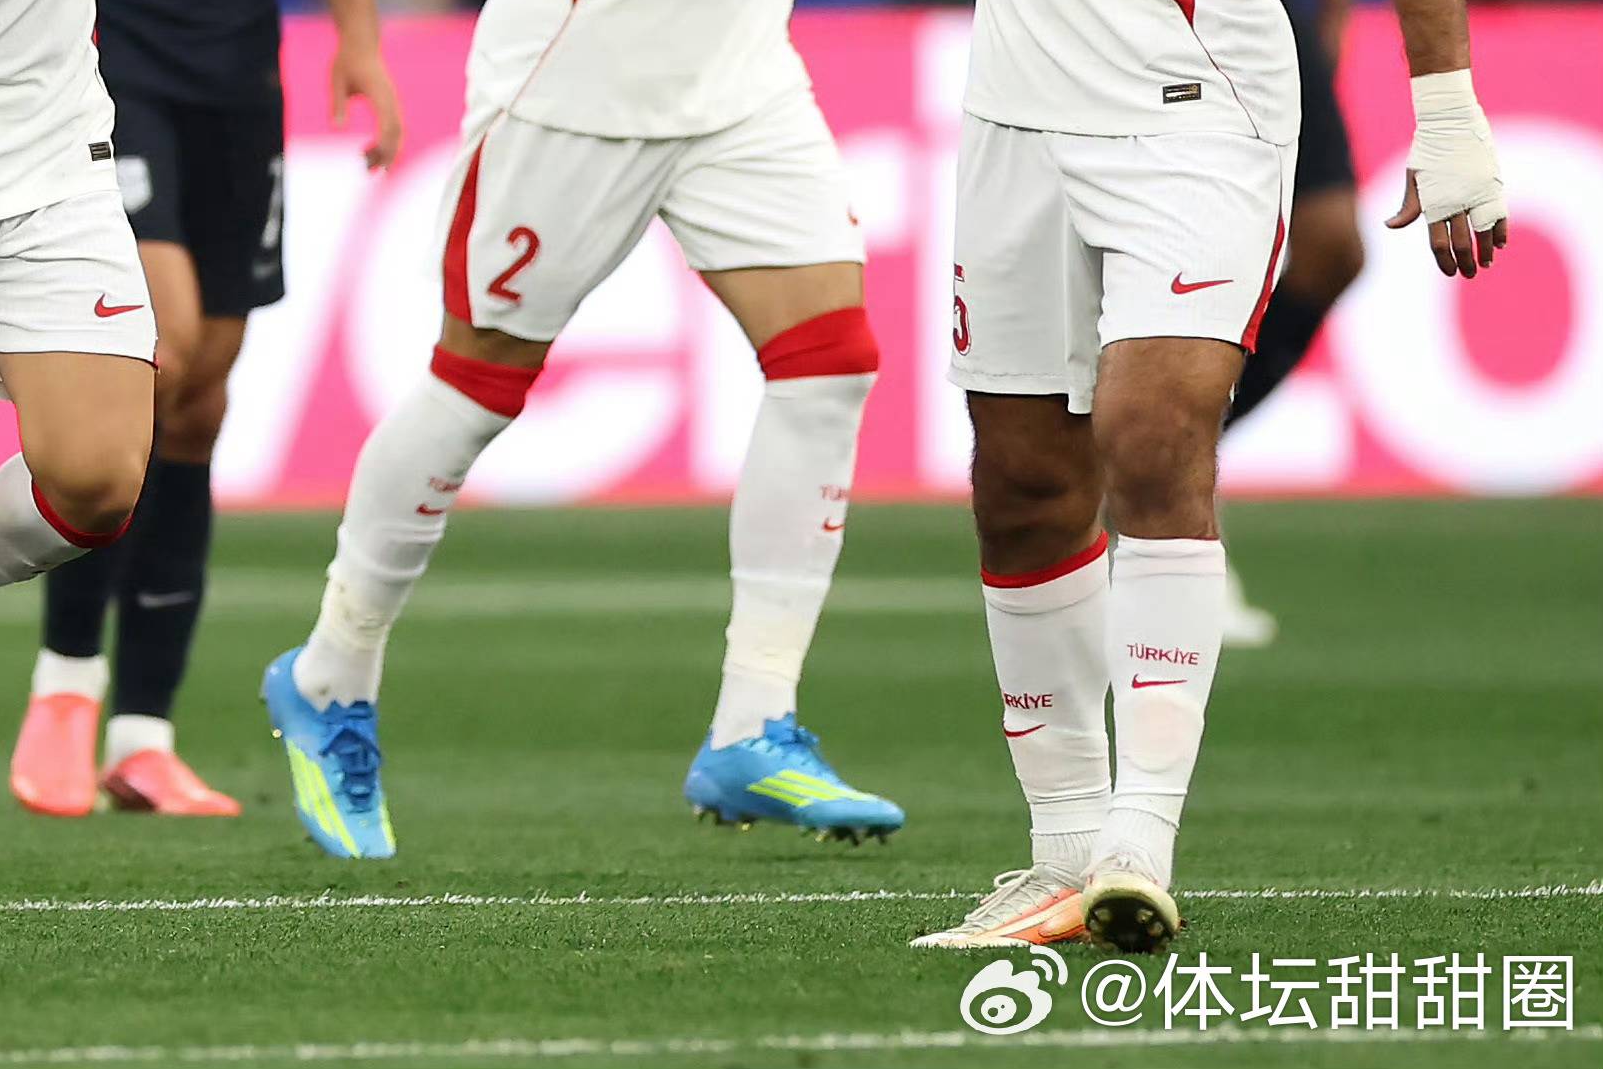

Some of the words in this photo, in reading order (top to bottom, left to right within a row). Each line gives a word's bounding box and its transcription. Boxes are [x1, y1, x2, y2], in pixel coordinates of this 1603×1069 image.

[487, 224, 541, 308] 2
[953, 263, 972, 356] 5
[1126, 643, 1200, 666] TÜRKİYE
[1002, 692, 1053, 710] RKİYE
